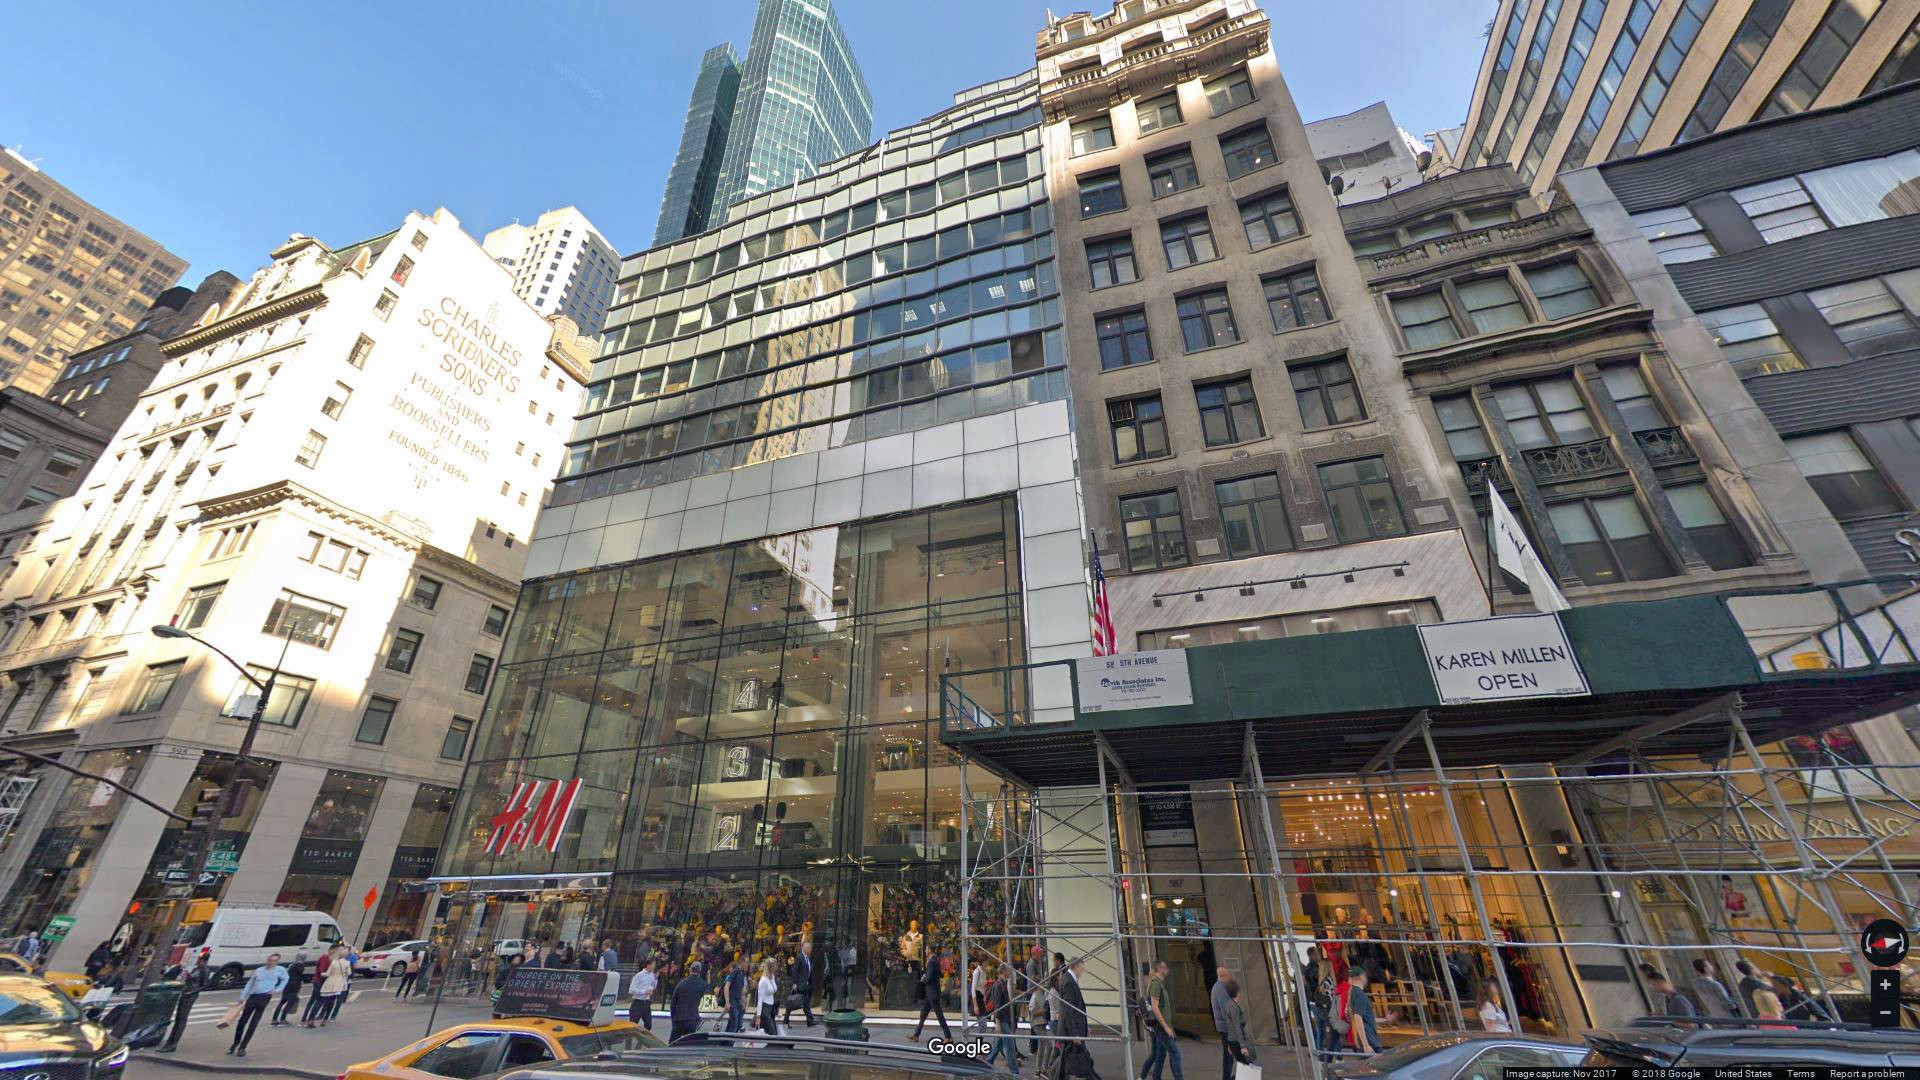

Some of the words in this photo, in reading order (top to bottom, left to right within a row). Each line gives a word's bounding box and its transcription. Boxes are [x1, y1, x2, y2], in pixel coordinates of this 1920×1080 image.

[440, 297, 522, 367] CHARLES
[440, 353, 488, 396] SONS
[411, 372, 491, 432] PUBLISHERS
[437, 408, 460, 426] AND
[389, 395, 490, 463] BOOKSELLERS
[389, 430, 438, 465] FOUNDED
[442, 463, 469, 482] 1846
[1134, 656, 1158, 666] AVENUE
[1435, 651, 1496, 670] KAREN
[1502, 646, 1566, 664] MILLEN
[736, 680, 756, 710] 4
[1478, 673, 1538, 691] OPEN
[726, 747, 748, 777] 3
[483, 778, 582, 855] H&M
[1809, 818, 1911, 840] XIANG
[715, 815, 737, 851] 2
[508, 979, 542, 989] ORIENT
[544, 981, 580, 992] EXPRESS
[515, 971, 548, 980] MURDER
[550, 972, 561, 980] ON
[565, 973, 580, 982] THE
